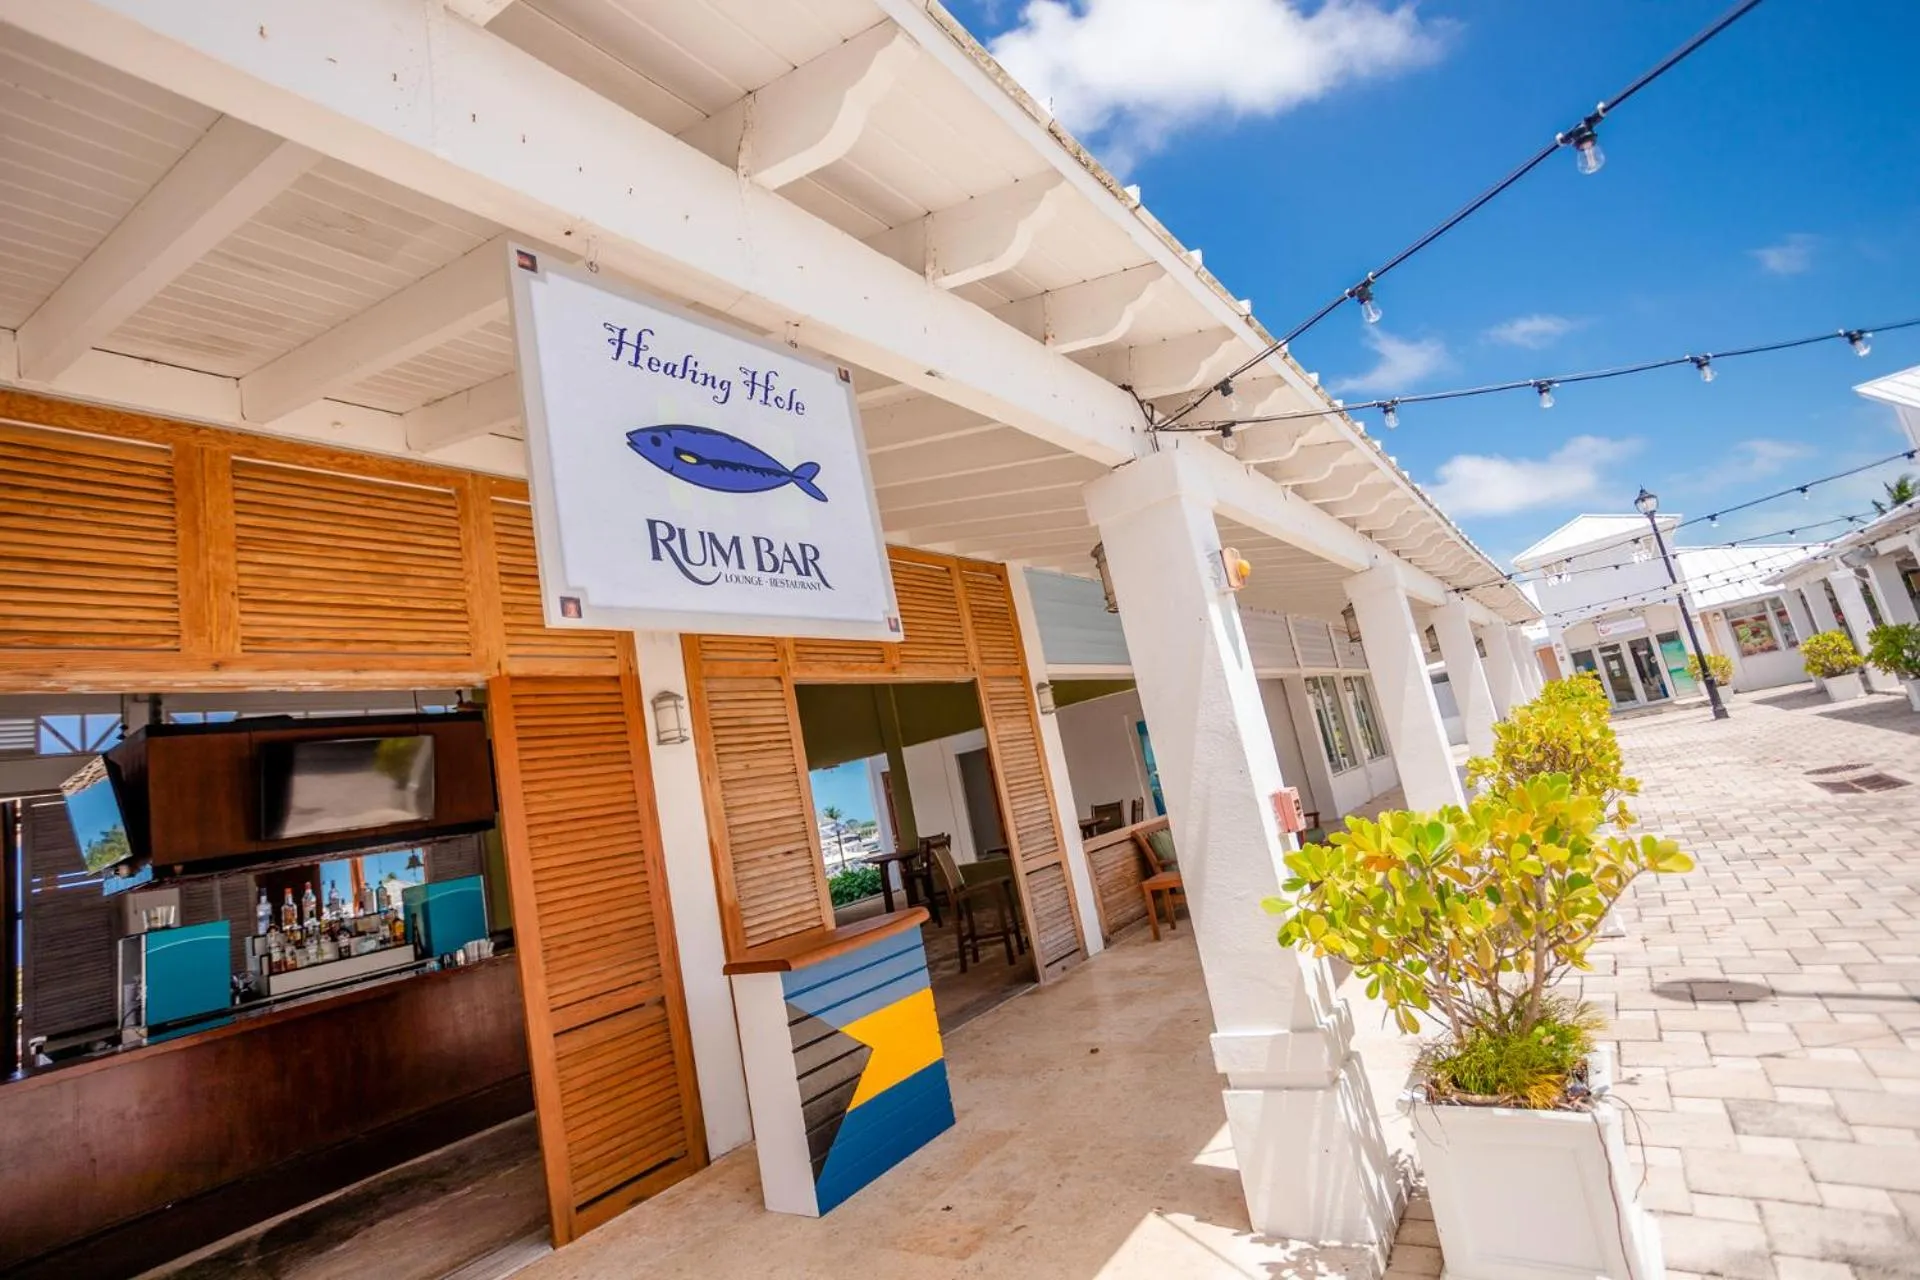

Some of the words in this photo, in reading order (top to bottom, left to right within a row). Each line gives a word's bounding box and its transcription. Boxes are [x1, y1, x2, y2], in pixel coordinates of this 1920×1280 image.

[603, 321, 731, 404] Healing
[739, 366, 806, 416] Hole
[646, 517, 746, 586] RUM
[753, 535, 835, 591] BAR
[725, 573, 764, 586] LOUNGE
[769, 578, 822, 591] RESTAURANT
